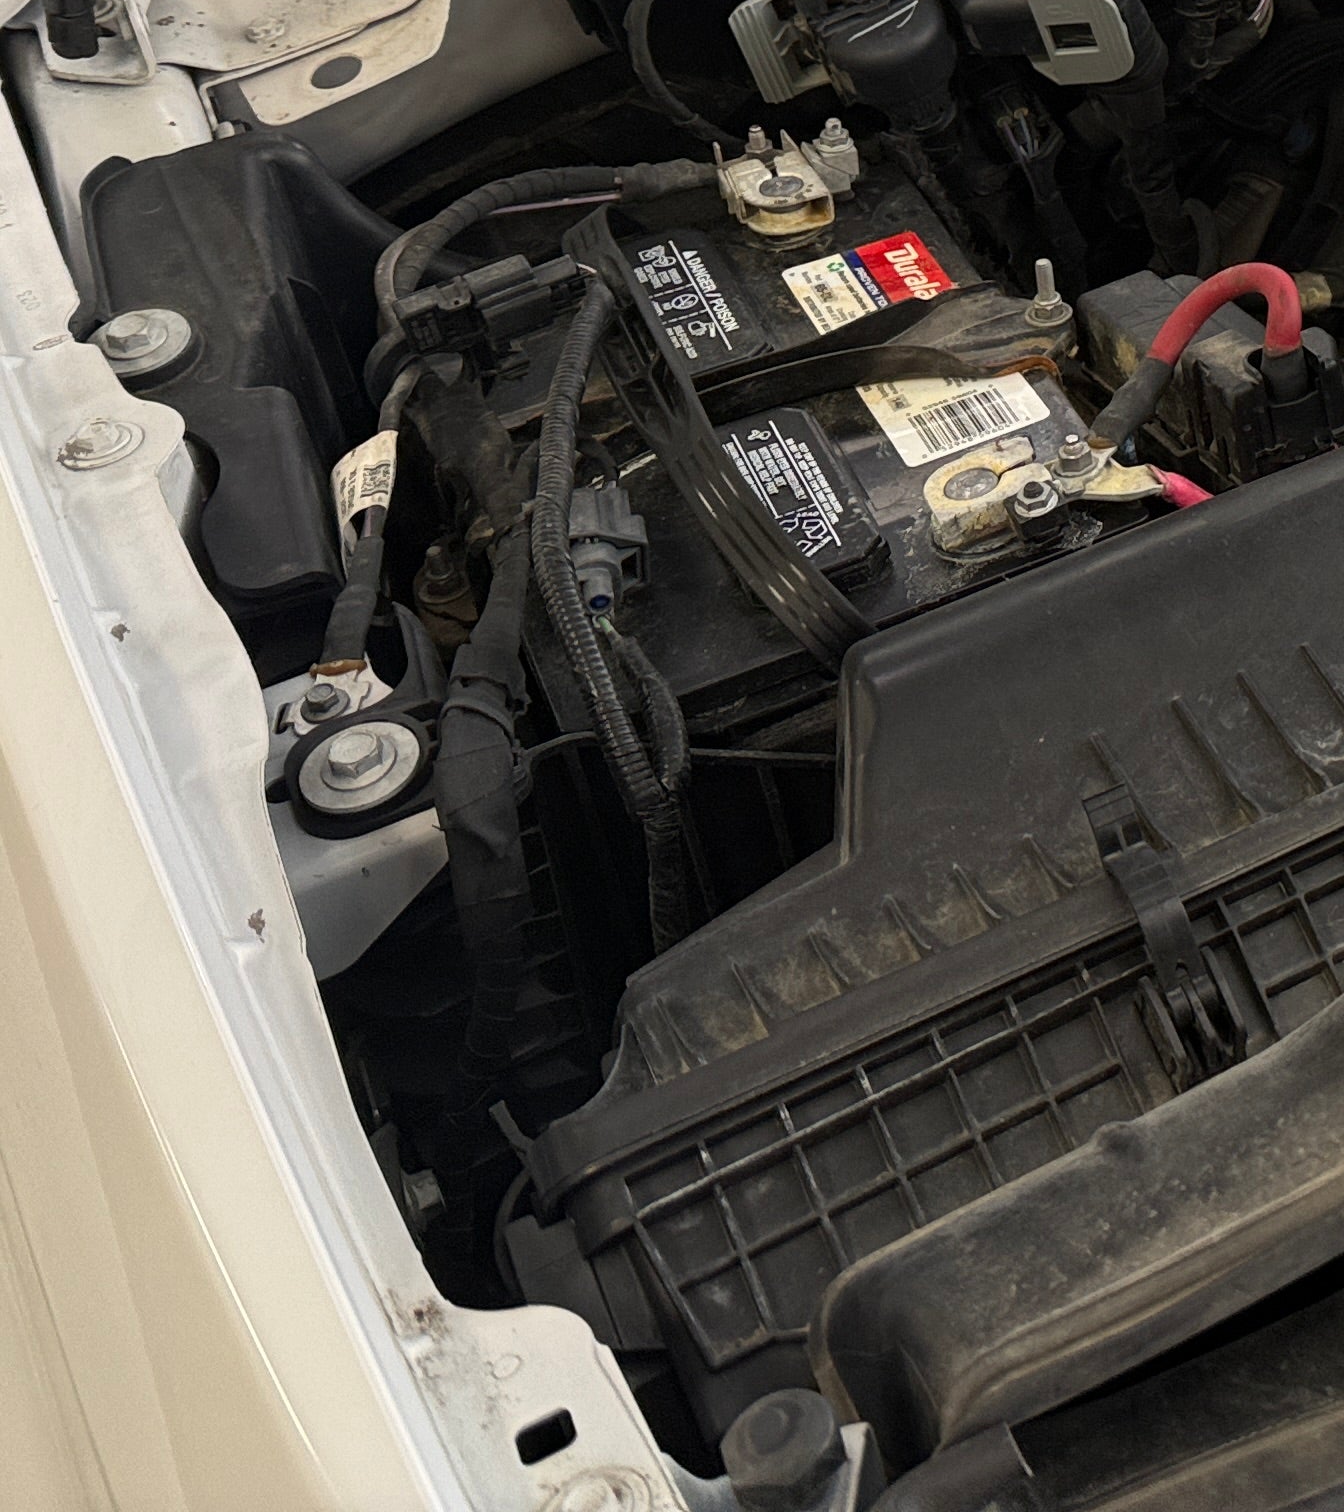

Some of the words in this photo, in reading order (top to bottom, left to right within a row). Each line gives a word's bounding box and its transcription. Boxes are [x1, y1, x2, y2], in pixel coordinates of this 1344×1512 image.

[685, 256, 717, 293] DANGER
[708, 296, 740, 334] POISON
[852, 265, 881, 295] PROVEN
